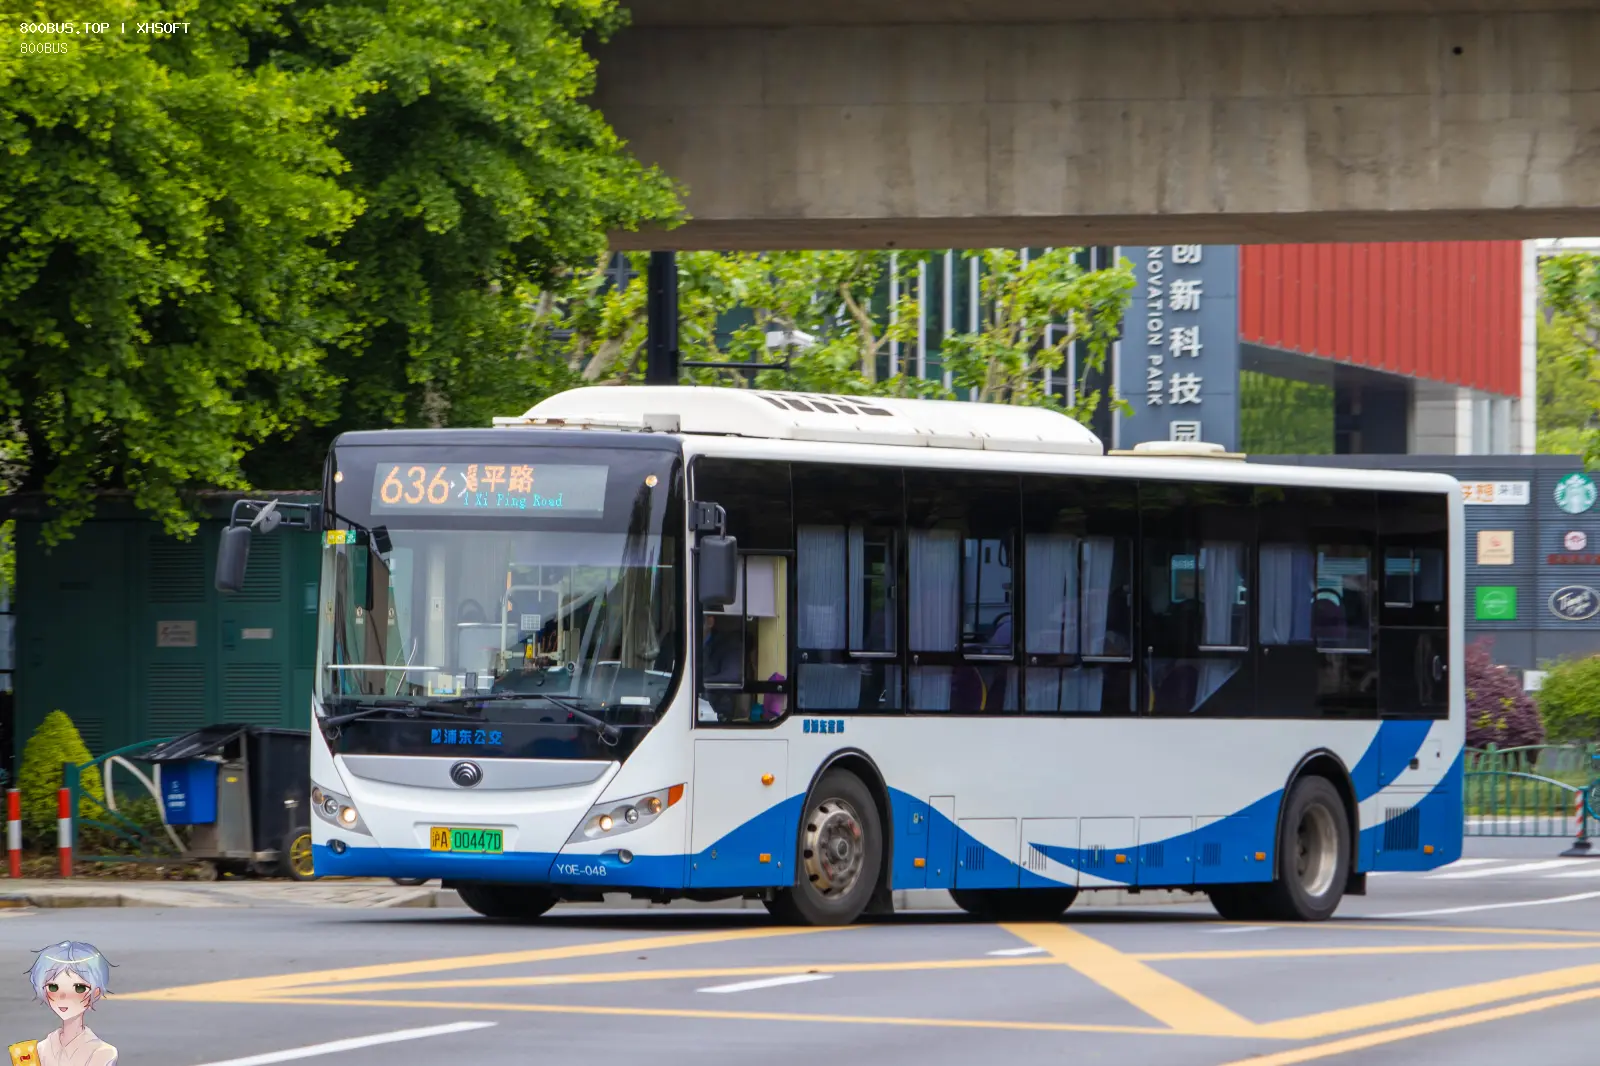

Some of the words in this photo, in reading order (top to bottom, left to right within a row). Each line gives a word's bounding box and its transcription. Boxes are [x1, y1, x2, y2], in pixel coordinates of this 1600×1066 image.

[1147, 354, 1164, 405] PARK
[381, 466, 448, 505] 636
[496, 493, 526, 510] Ping
[532, 493, 564, 507] Road
[443, 729, 502, 745] 浦东公交
[432, 831, 448, 848] 沪A
[454, 832, 501, 850] 00447D
